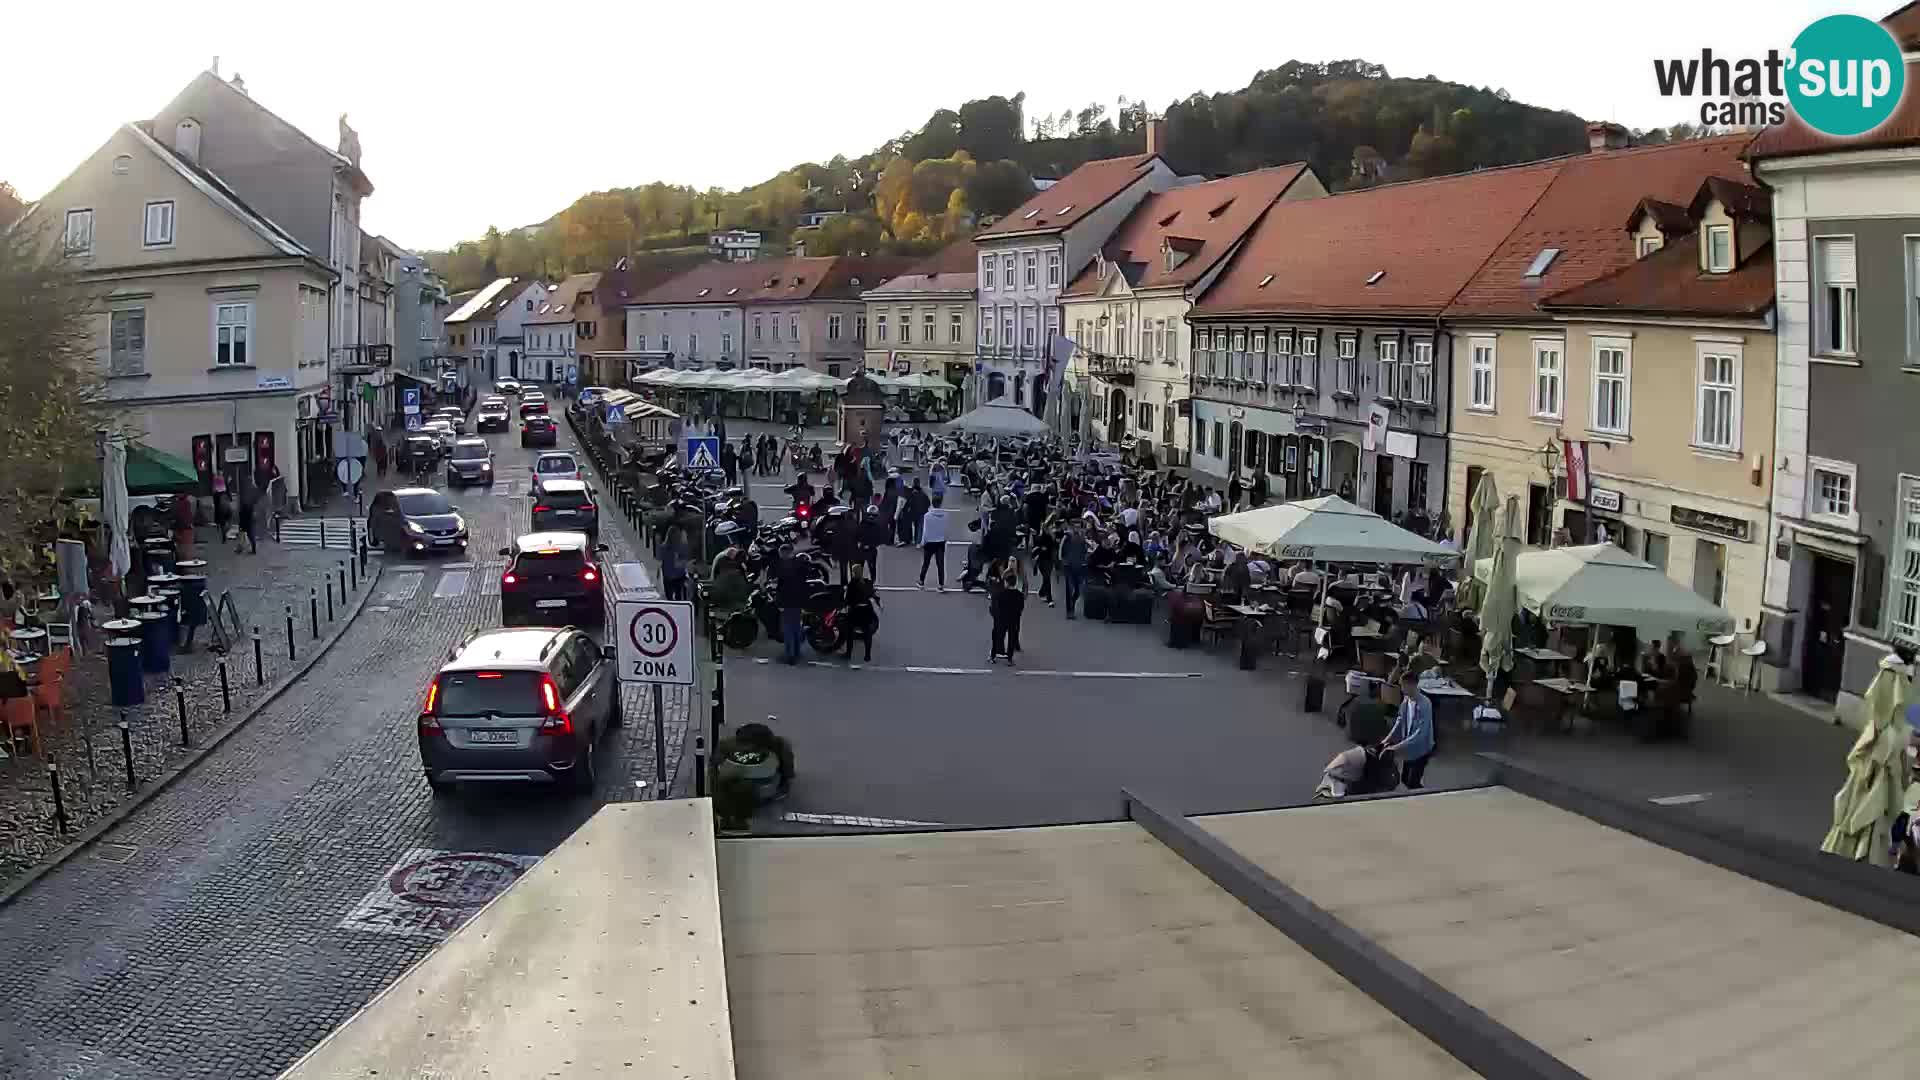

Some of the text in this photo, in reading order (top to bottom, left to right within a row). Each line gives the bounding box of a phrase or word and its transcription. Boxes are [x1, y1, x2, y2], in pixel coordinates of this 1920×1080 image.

[407, 392, 416, 404] P
[642, 623, 667, 644] 30
[633, 660, 677, 677] ZONA
